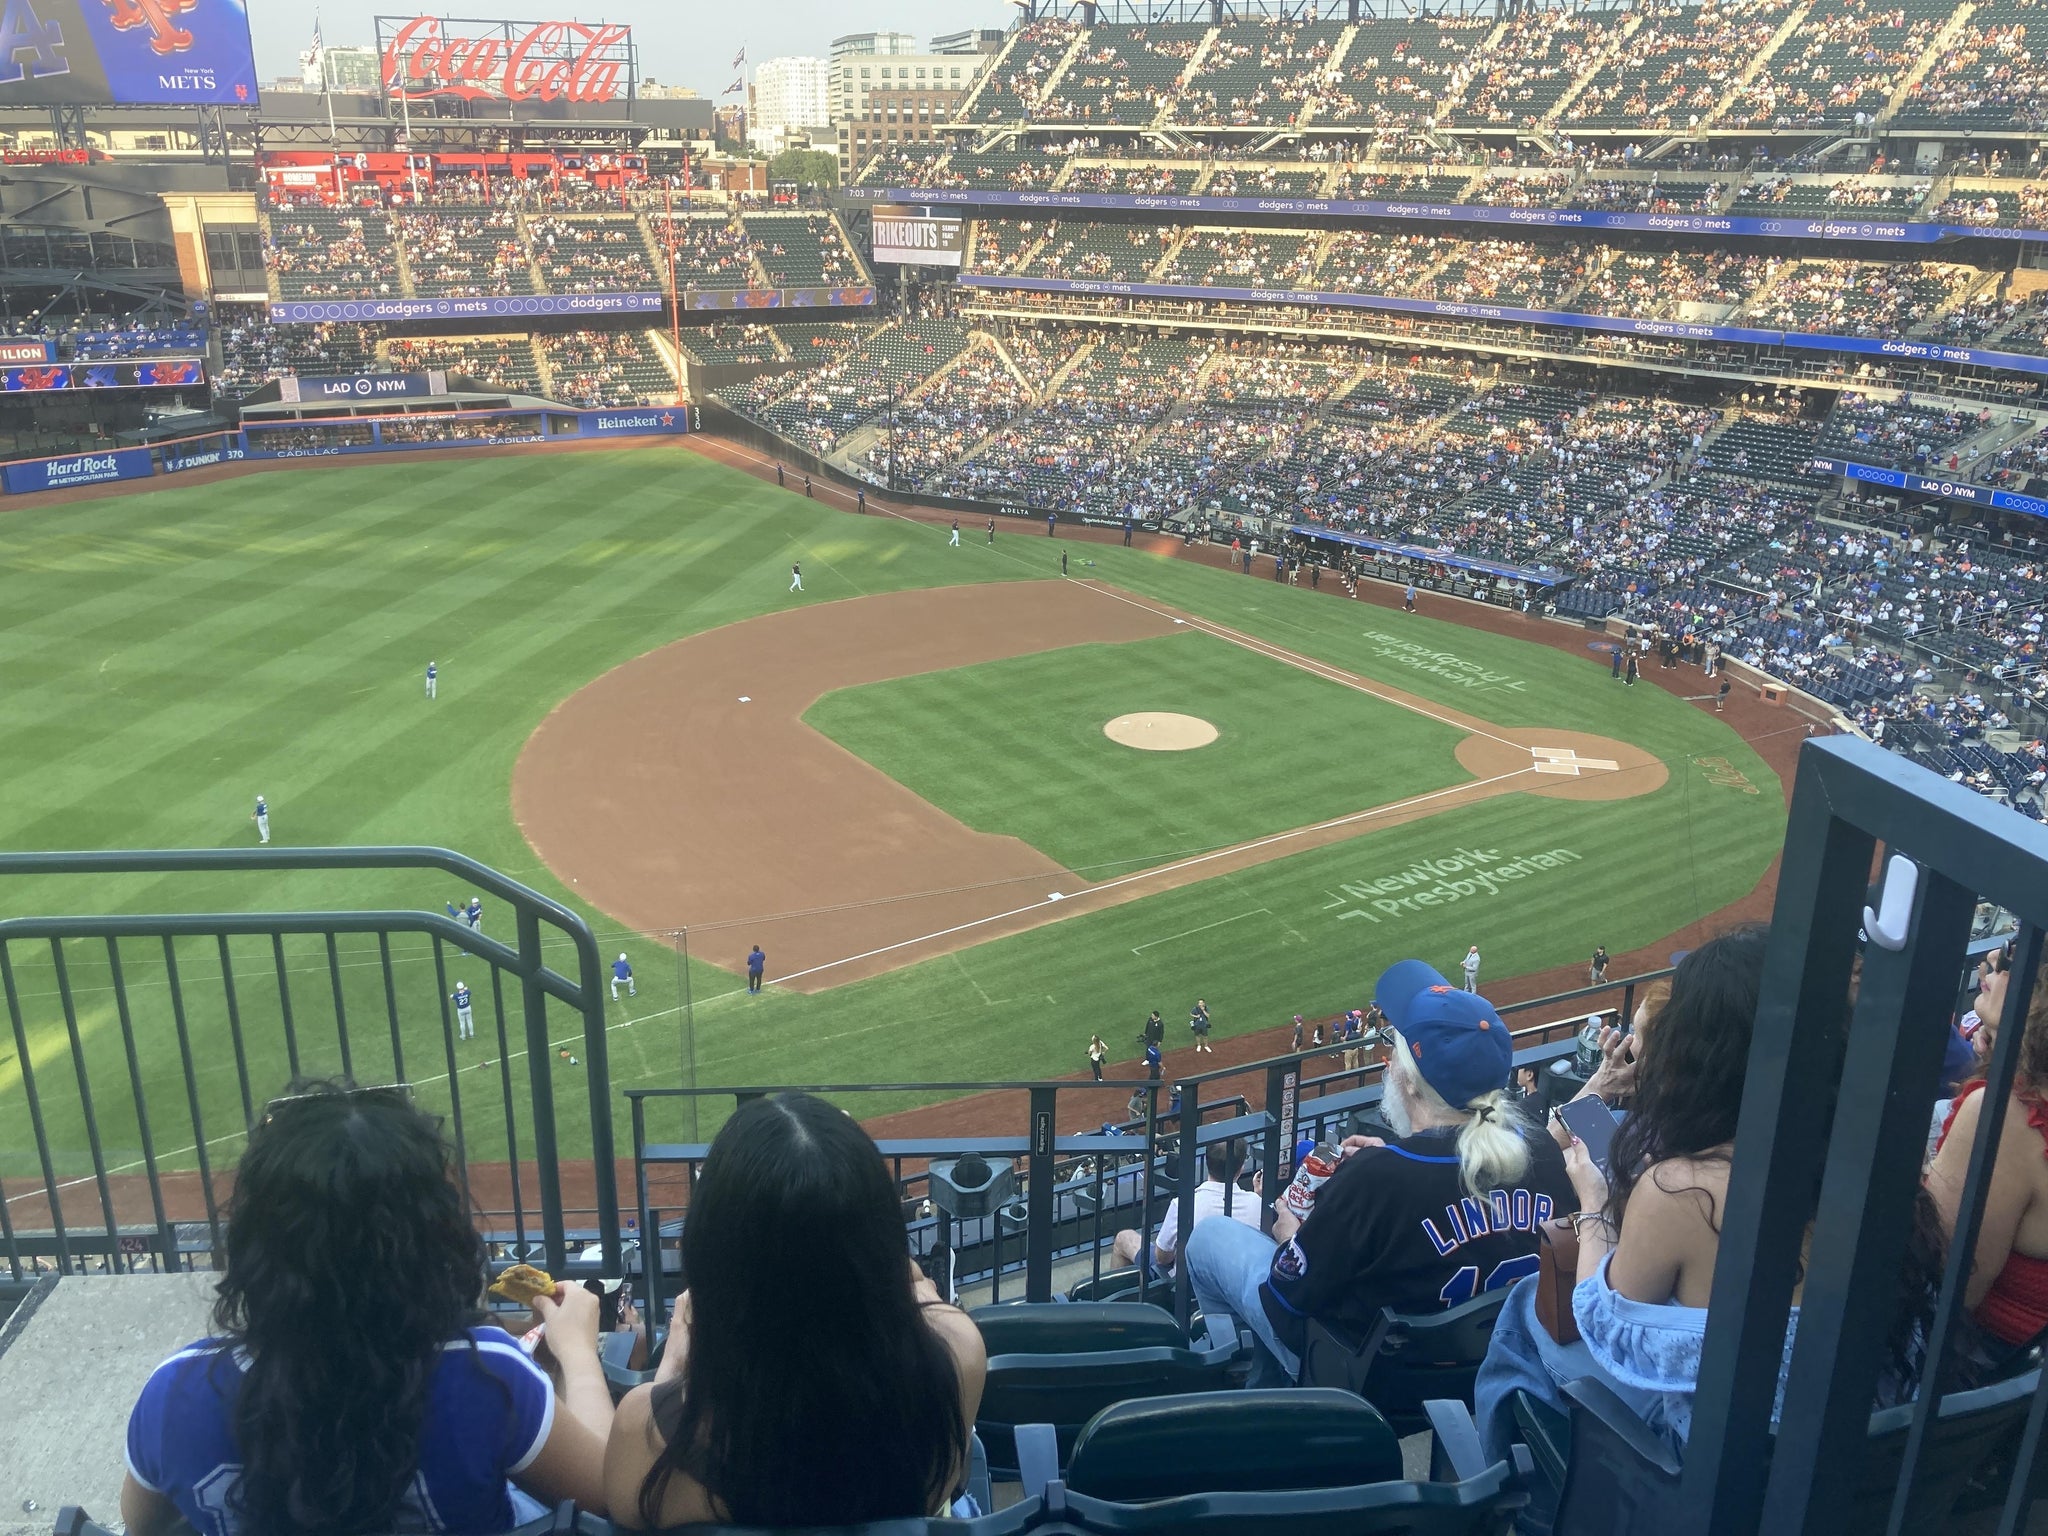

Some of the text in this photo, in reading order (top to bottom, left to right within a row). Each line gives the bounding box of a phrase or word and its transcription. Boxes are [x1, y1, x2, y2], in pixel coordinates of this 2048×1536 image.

[382, 16, 631, 103] Coca-Cola
[159, 75, 216, 89] METS
[849, 189, 865, 198] 7:03
[910, 191, 939, 200] dodgers
[950, 192, 968, 200] mets
[1019, 193, 1049, 203] dodgers
[1061, 195, 1080, 203] mets
[1134, 196, 1168, 207] dodgers
[1180, 198, 1200, 207] mets
[1259, 200, 1293, 210] dodgers
[1307, 202, 1329, 211] mets
[1387, 205, 1418, 215] dodgers
[1431, 207, 1451, 216] mets
[1510, 210, 1546, 221] dodgers
[1559, 212, 1582, 223] mets
[1648, 216, 1689, 229] dodgers
[1705, 220, 1731, 229] mets
[1808, 222, 1857, 236] dodgers
[1876, 226, 1906, 236] mets
[1070, 282, 1101, 292] dodgers
[1112, 284, 1131, 292] mets
[1251, 290, 1284, 301] dodgers
[1297, 293, 1318, 301] mets
[570, 297, 623, 310] dodgers
[642, 298, 662, 306] me
[1436, 302, 1468, 315] dodgers
[1480, 306, 1501, 316] mets
[377, 302, 433, 319] dodgers
[454, 302, 488, 313] mets
[1634, 321, 1673, 334] dodgers
[1689, 326, 1714, 336] mets
[0, 348, 42, 360] ILION
[1882, 341, 1927, 356] dodgers
[1943, 349, 1970, 360] mets
[323, 382, 350, 394] LAD
[377, 380, 406, 392] NYM
[597, 415, 657, 430] Heineken
[488, 435, 545, 446] CADILLAC
[186, 452, 221, 468] DUNKIN'
[227, 450, 244, 459] 370
[277, 448, 339, 459] CADILLAC
[47, 454, 117, 477] Hard Rock
[1814, 461, 1832, 471] NYM
[58, 473, 104, 485] METROPOLITAN
[103, 471, 119, 479] PARK
[1921, 480, 1938, 492] LAD
[1955, 488, 1976, 499] NYM
[1007, 507, 1030, 516] DELTA
[1362, 631, 1510, 683] Presbyterian
[1340, 847, 1501, 899] NewYork-
[1371, 848, 1583, 918] Presbyterian
[1421, 1188, 1554, 1256] LINDOR
